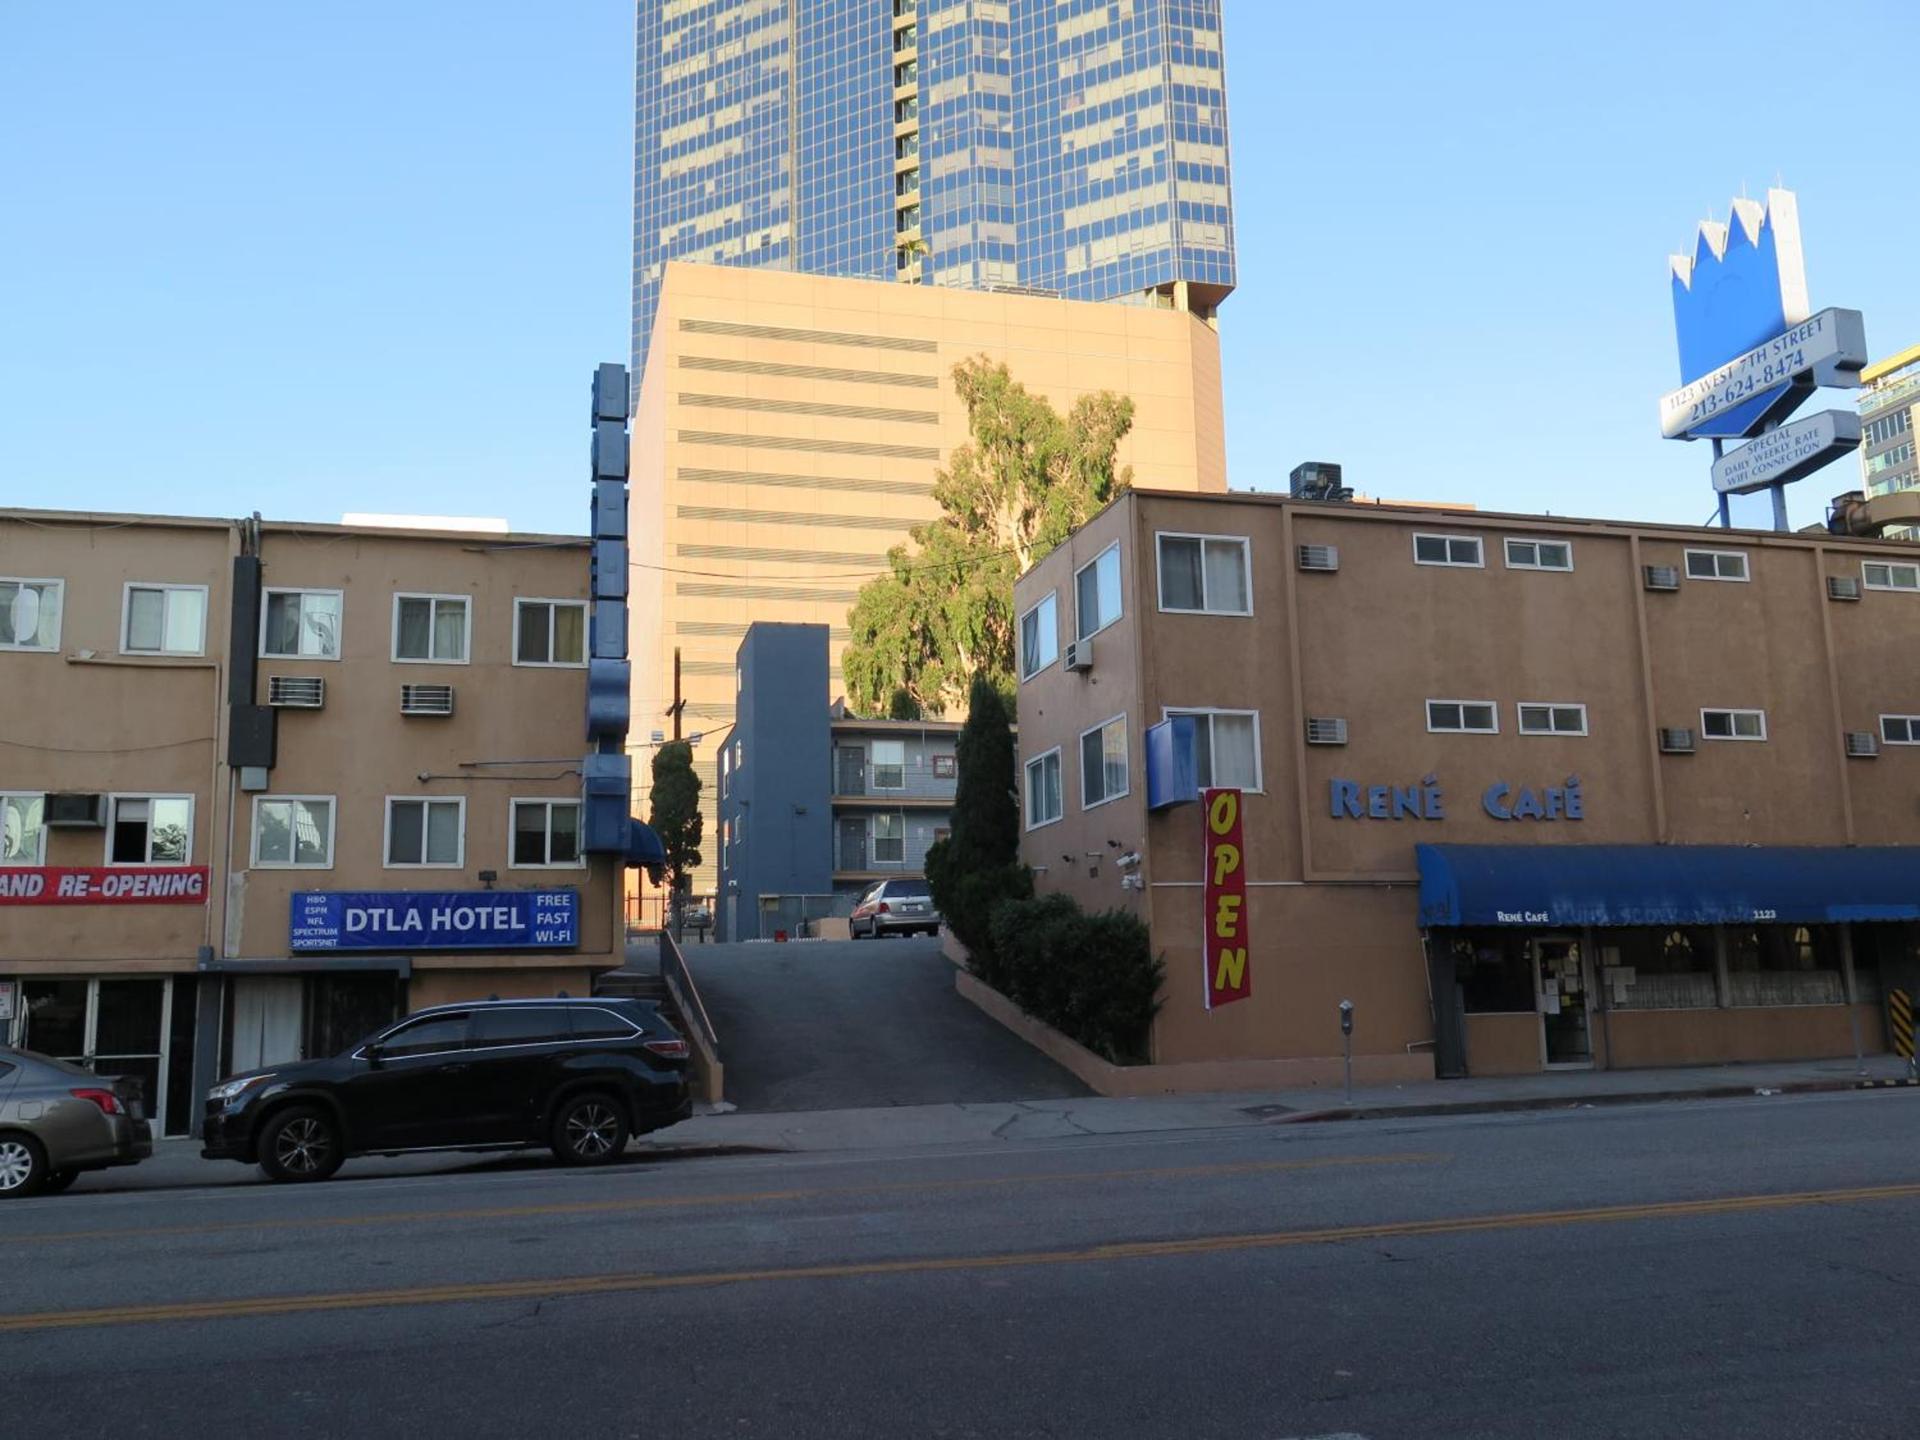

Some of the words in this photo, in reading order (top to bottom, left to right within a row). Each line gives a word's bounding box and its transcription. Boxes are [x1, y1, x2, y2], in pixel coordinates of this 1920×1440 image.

[1699, 366, 1734, 393] WEST
[1740, 347, 1767, 373] 7TH
[1773, 317, 1823, 354] STREET
[1690, 349, 1804, 420] 213-624-8474
[1748, 428, 1791, 455] SPECIAL
[1725, 460, 1750, 477] DAILY
[1754, 442, 1790, 463] WEEKLY
[1795, 428, 1820, 446] RATE
[1752, 442, 1820, 476] CONNECTION
[57, 873, 202, 897] RE-OPENING
[1208, 792, 1247, 990] OPEN
[306, 895, 327, 904] HBO
[537, 895, 570, 907] FREE
[305, 907, 328, 915] ESPN
[1753, 909, 1777, 919] 1123
[307, 917, 325, 926] NFL
[346, 908, 423, 932] DTLA
[431, 907, 526, 931] HOTEL
[537, 912, 570, 925] FAST
[293, 928, 338, 936] SPECTRUM
[535, 930, 571, 943] WI-FI
[292, 939, 338, 947] SPORTSNET
